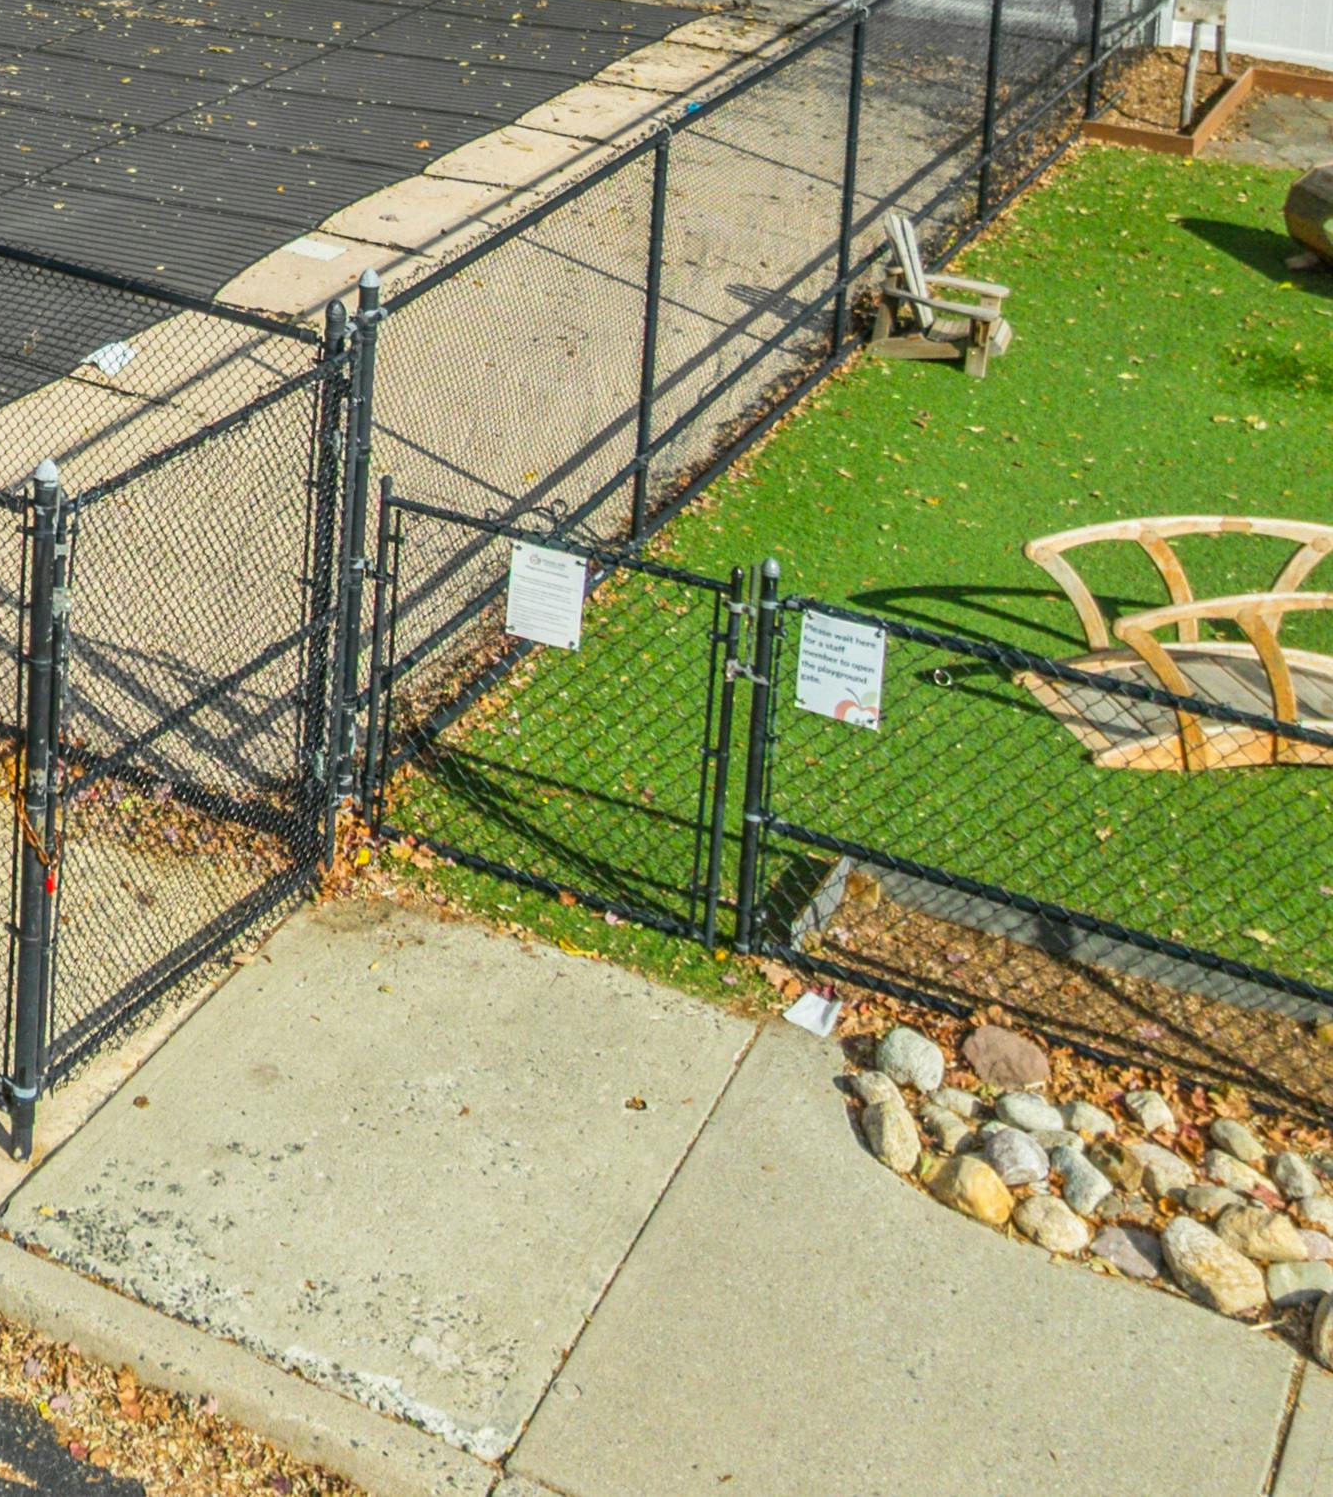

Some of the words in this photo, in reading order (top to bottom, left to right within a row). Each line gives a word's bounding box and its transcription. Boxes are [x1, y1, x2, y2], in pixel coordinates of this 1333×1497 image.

[804, 635, 815, 644] for
[825, 643, 845, 653] staff
[805, 623, 832, 636] Please
[834, 634, 853, 644] wait
[855, 637, 876, 648] here
[802, 660, 815, 669] the
[818, 666, 867, 684] playground
[803, 650, 838, 662] member
[840, 659, 850, 667] to
[852, 663, 875, 673] open
